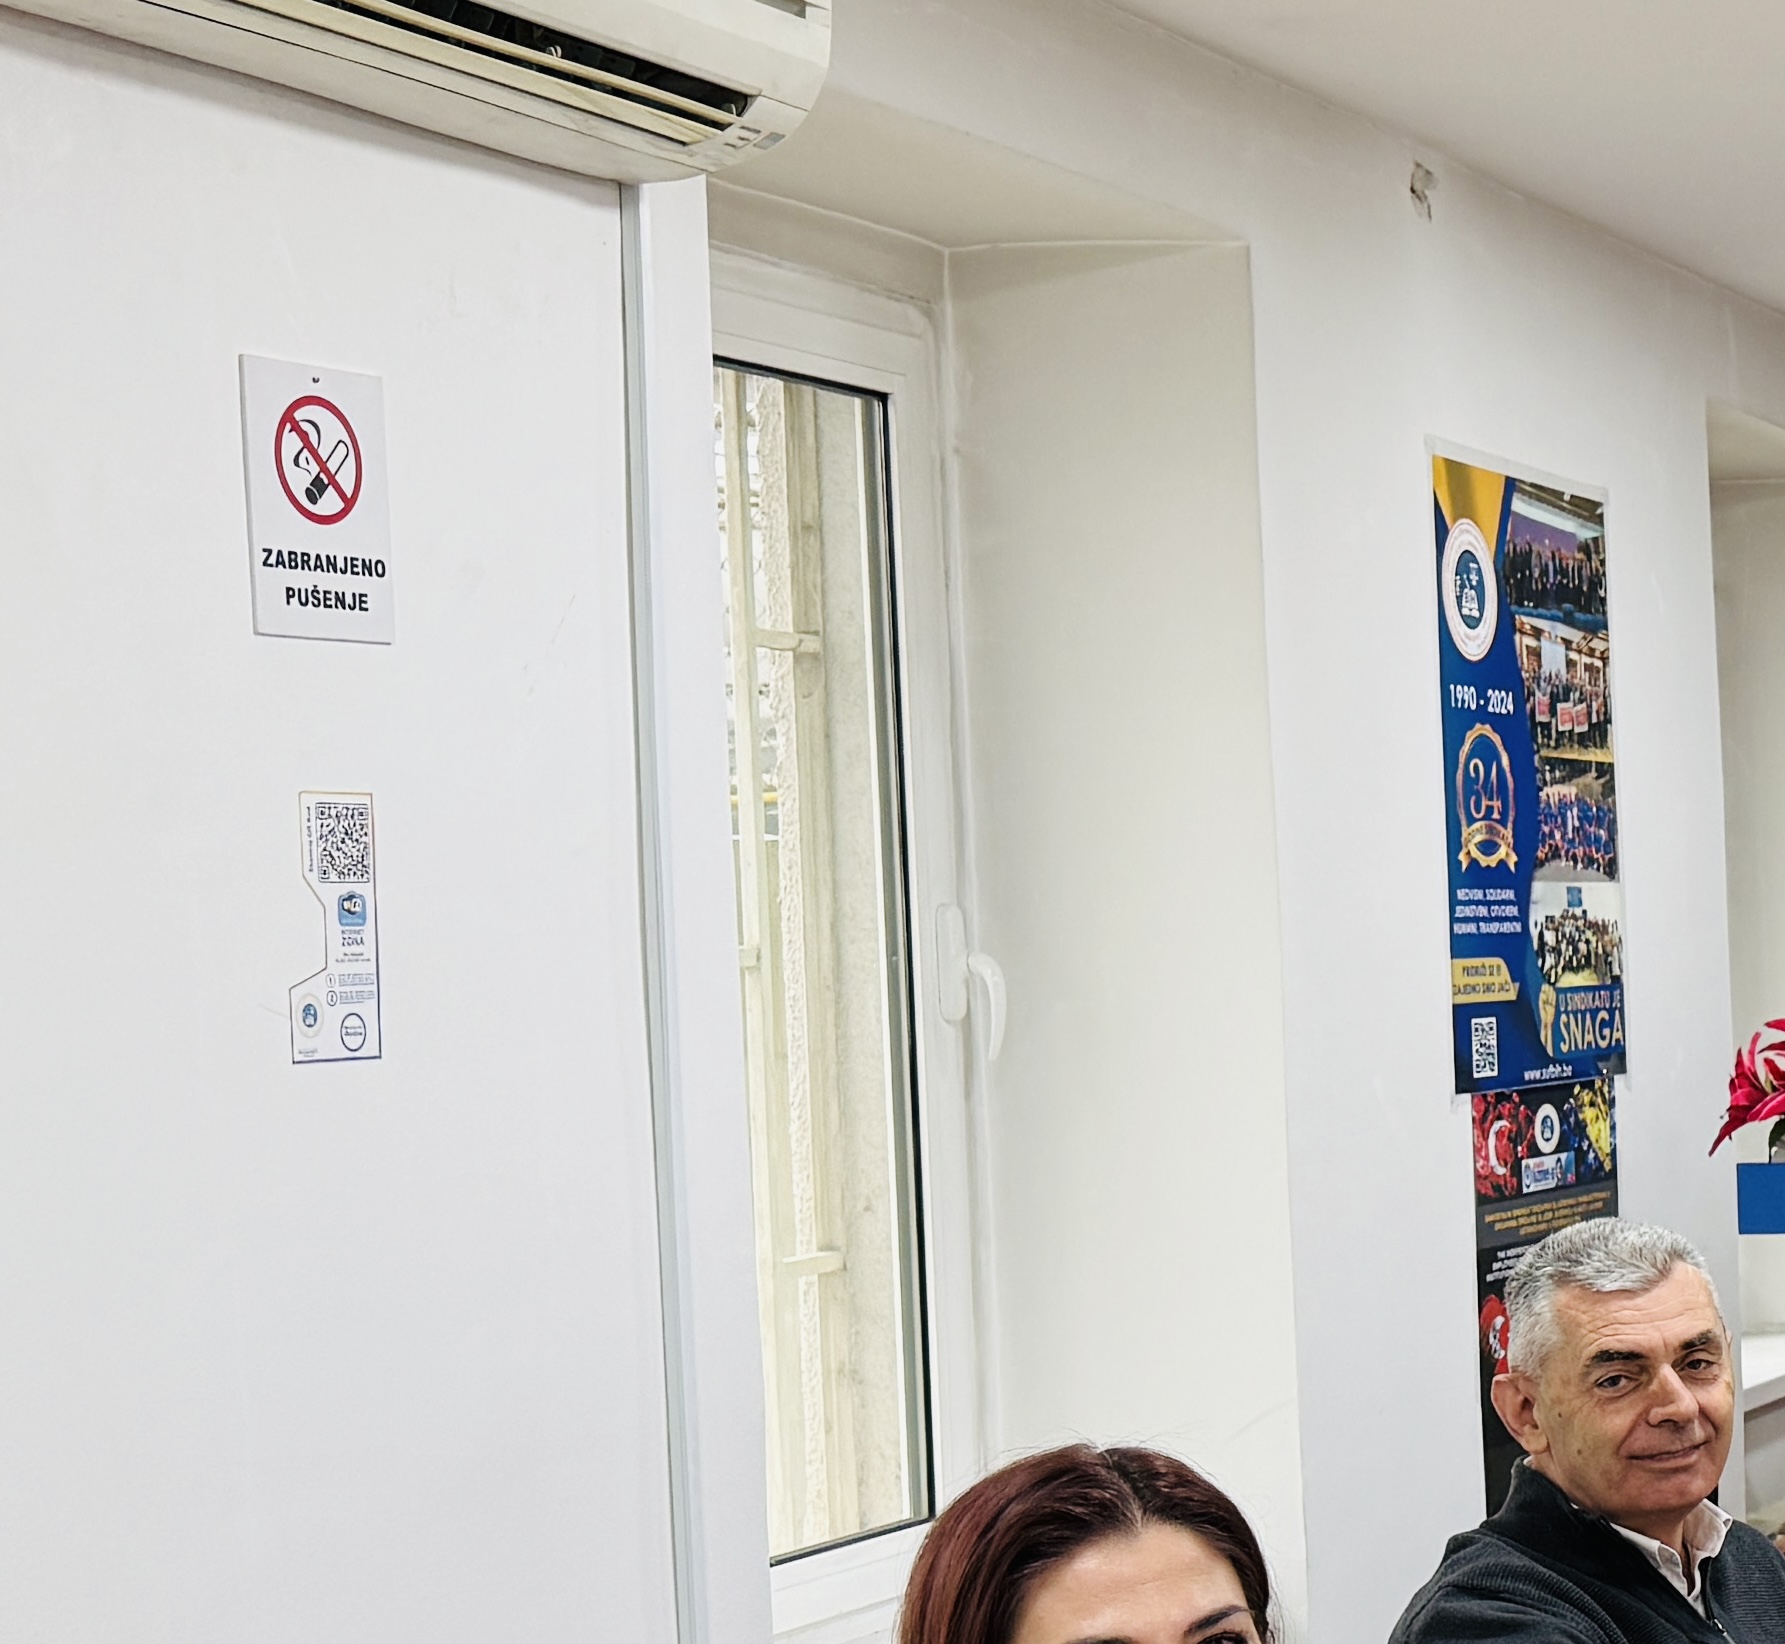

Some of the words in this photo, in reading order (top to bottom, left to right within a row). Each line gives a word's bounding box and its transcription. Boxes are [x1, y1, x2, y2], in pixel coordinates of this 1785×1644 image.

[262, 547, 387, 579] ZABRANJENO
[285, 584, 370, 612] PUŠENJE
[1487, 689, 1514, 715] 2024
[1469, 757, 1503, 821] 34
[1559, 1009, 1625, 1054] SNAGA
